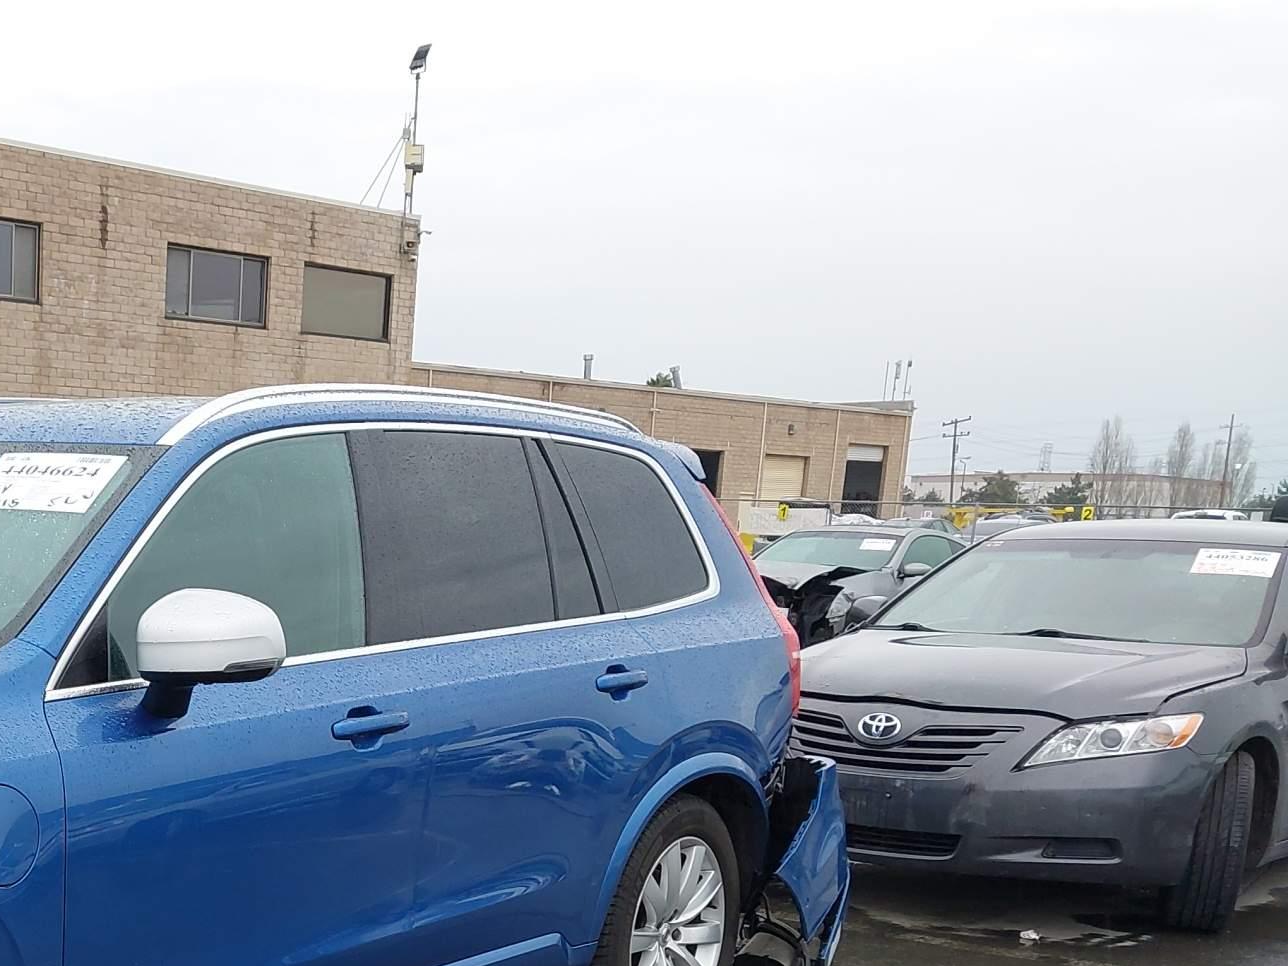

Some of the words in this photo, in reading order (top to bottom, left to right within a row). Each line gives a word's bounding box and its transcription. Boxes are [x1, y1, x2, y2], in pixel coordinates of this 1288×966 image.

[1, 464, 101, 477] 44046624
[780, 506, 787, 518] 1
[1083, 508, 1092, 520] 2
